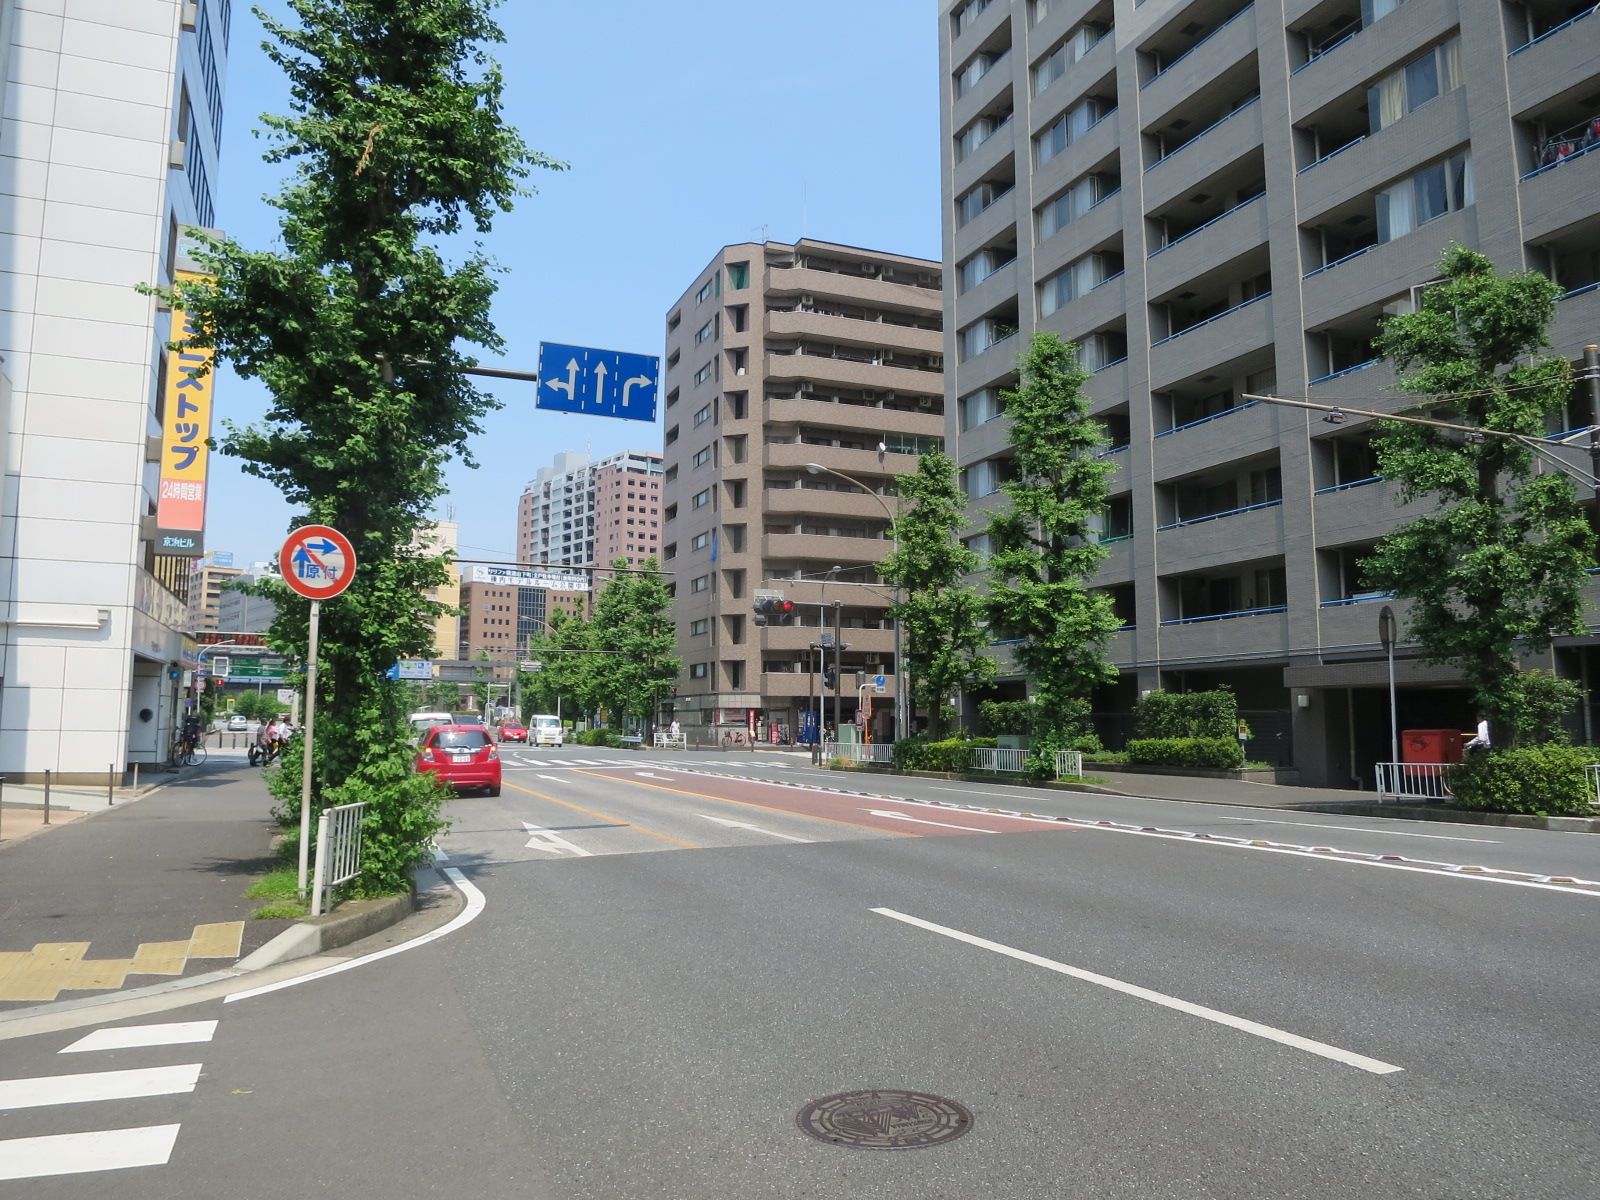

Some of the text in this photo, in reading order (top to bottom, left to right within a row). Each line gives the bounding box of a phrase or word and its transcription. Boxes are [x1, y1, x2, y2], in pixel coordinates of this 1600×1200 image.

[162, 481, 202, 501] 24時間営業
[163, 536, 195, 548] 京浜ビル
[306, 564, 338, 580] 原付
